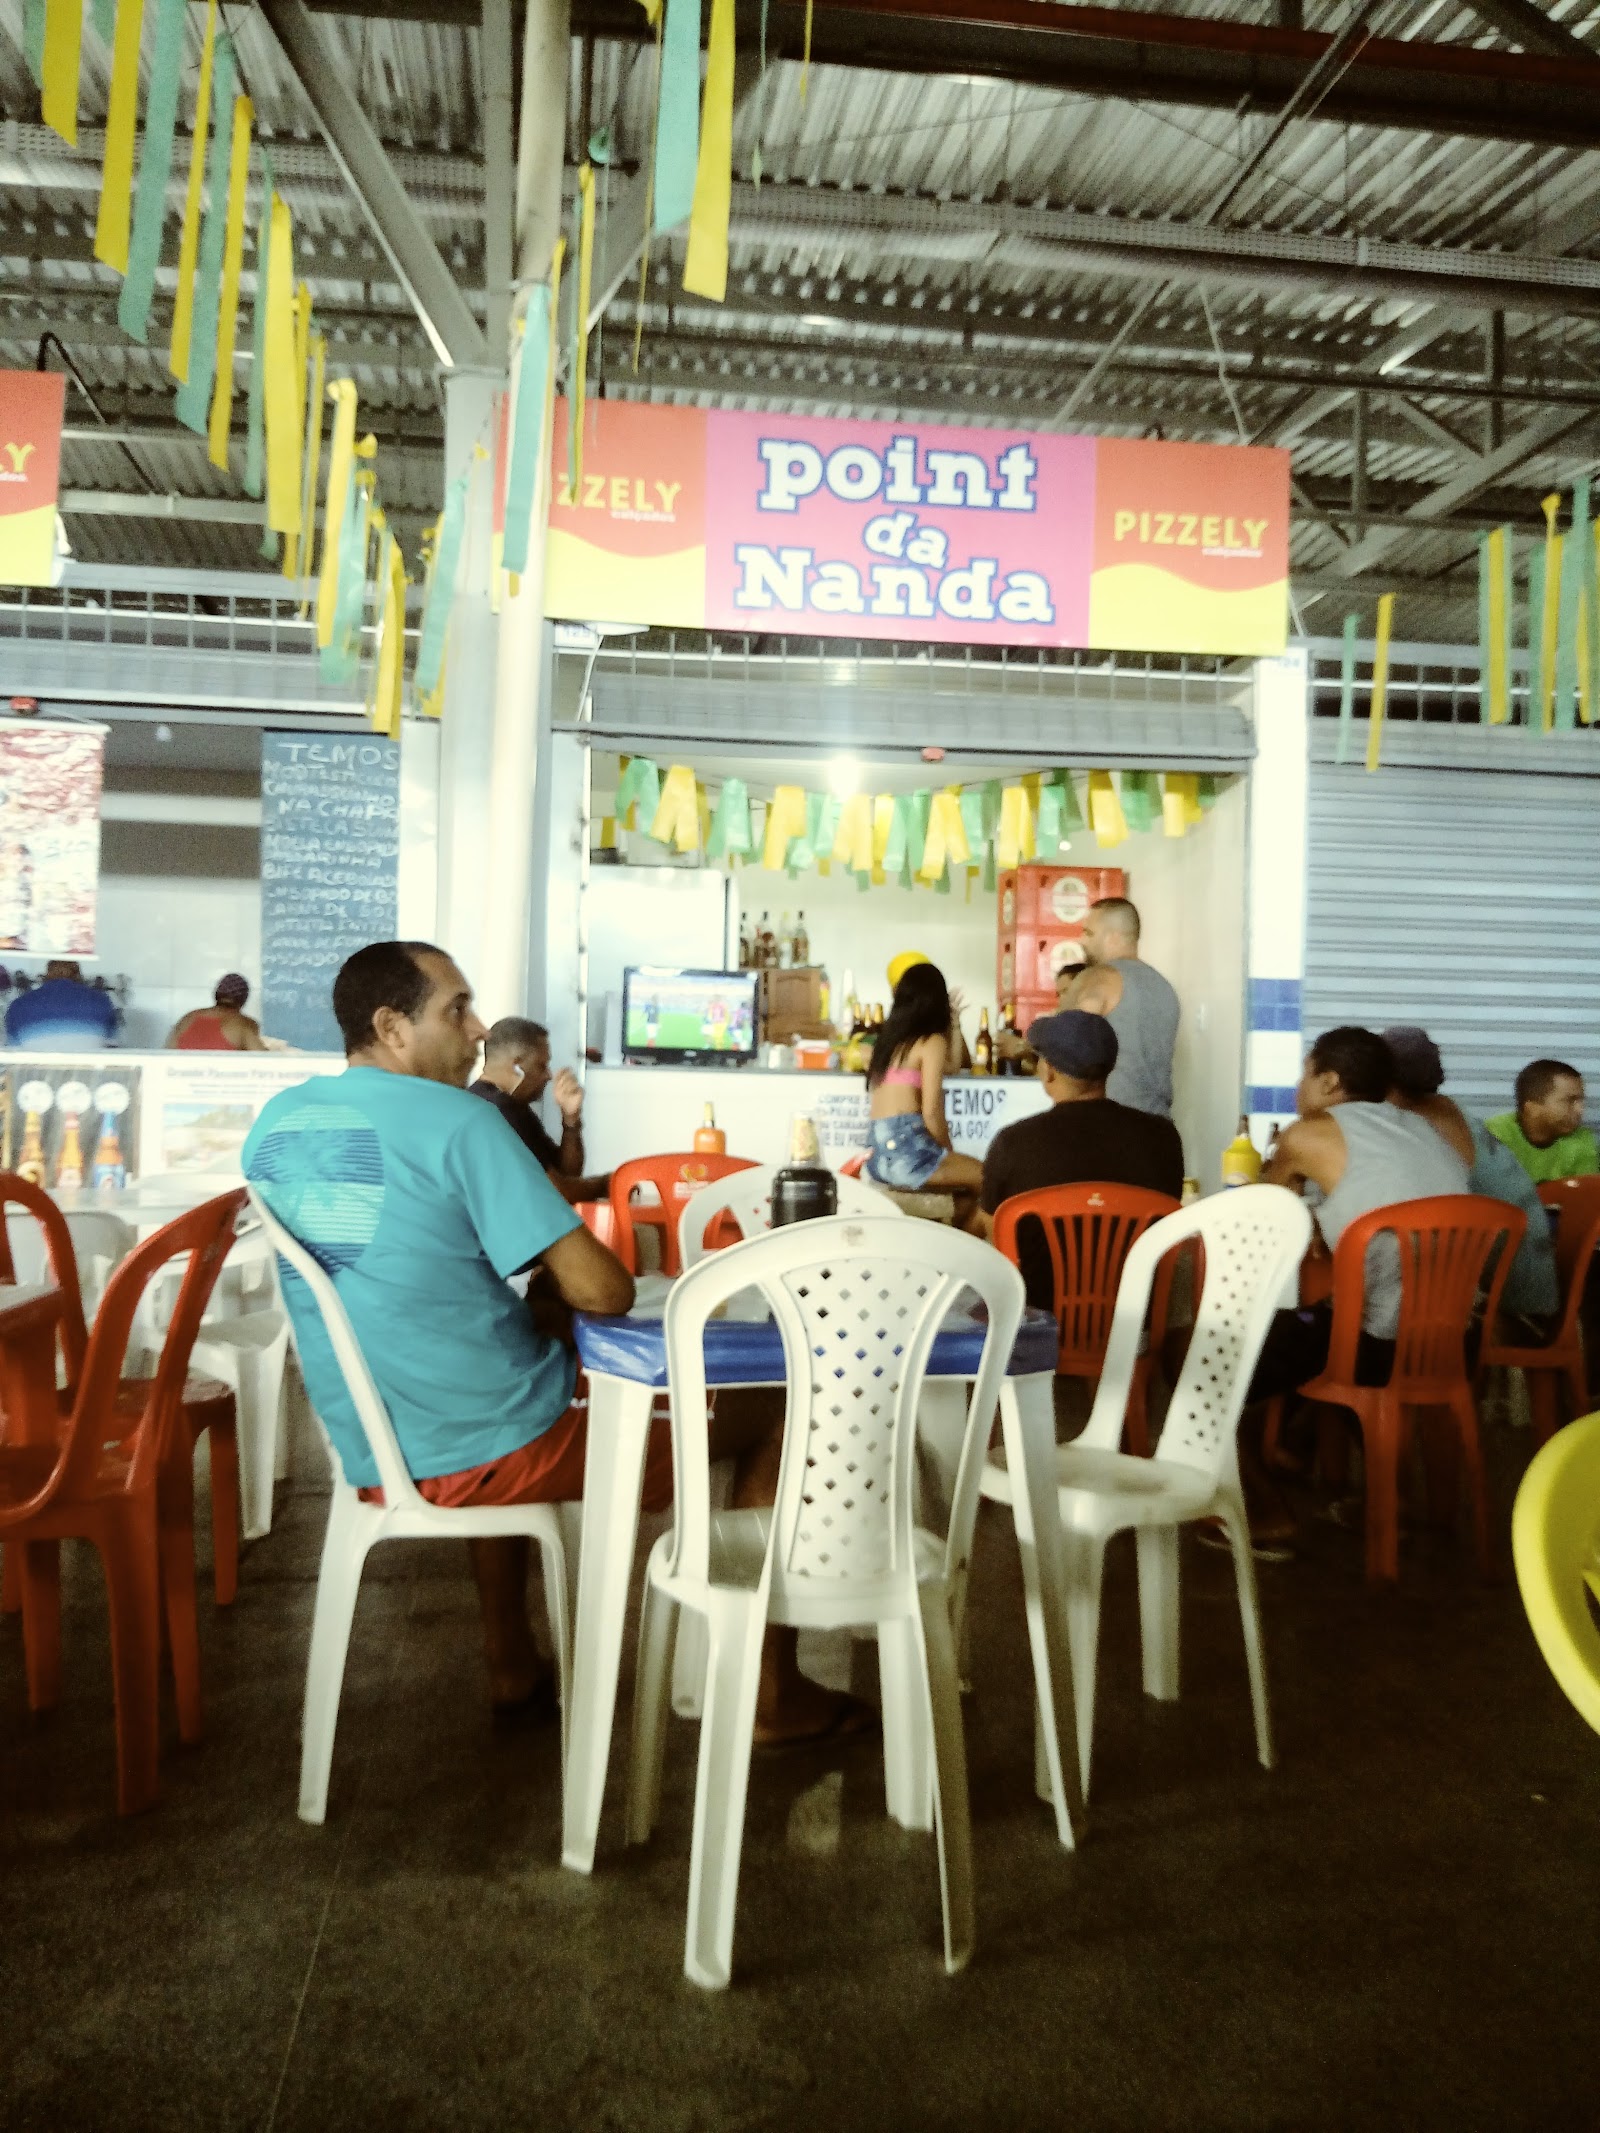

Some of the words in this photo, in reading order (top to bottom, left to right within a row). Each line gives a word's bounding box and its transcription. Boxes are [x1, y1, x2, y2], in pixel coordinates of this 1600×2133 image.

[556, 472, 682, 513] ZZELY
[758, 434, 1038, 513] point
[864, 511, 949, 568] da
[1114, 508, 1269, 551] PIZZELY
[734, 545, 1055, 625] Nanda
[277, 743, 399, 770] TEMOS
[943, 1089, 1007, 1115] EMOS
